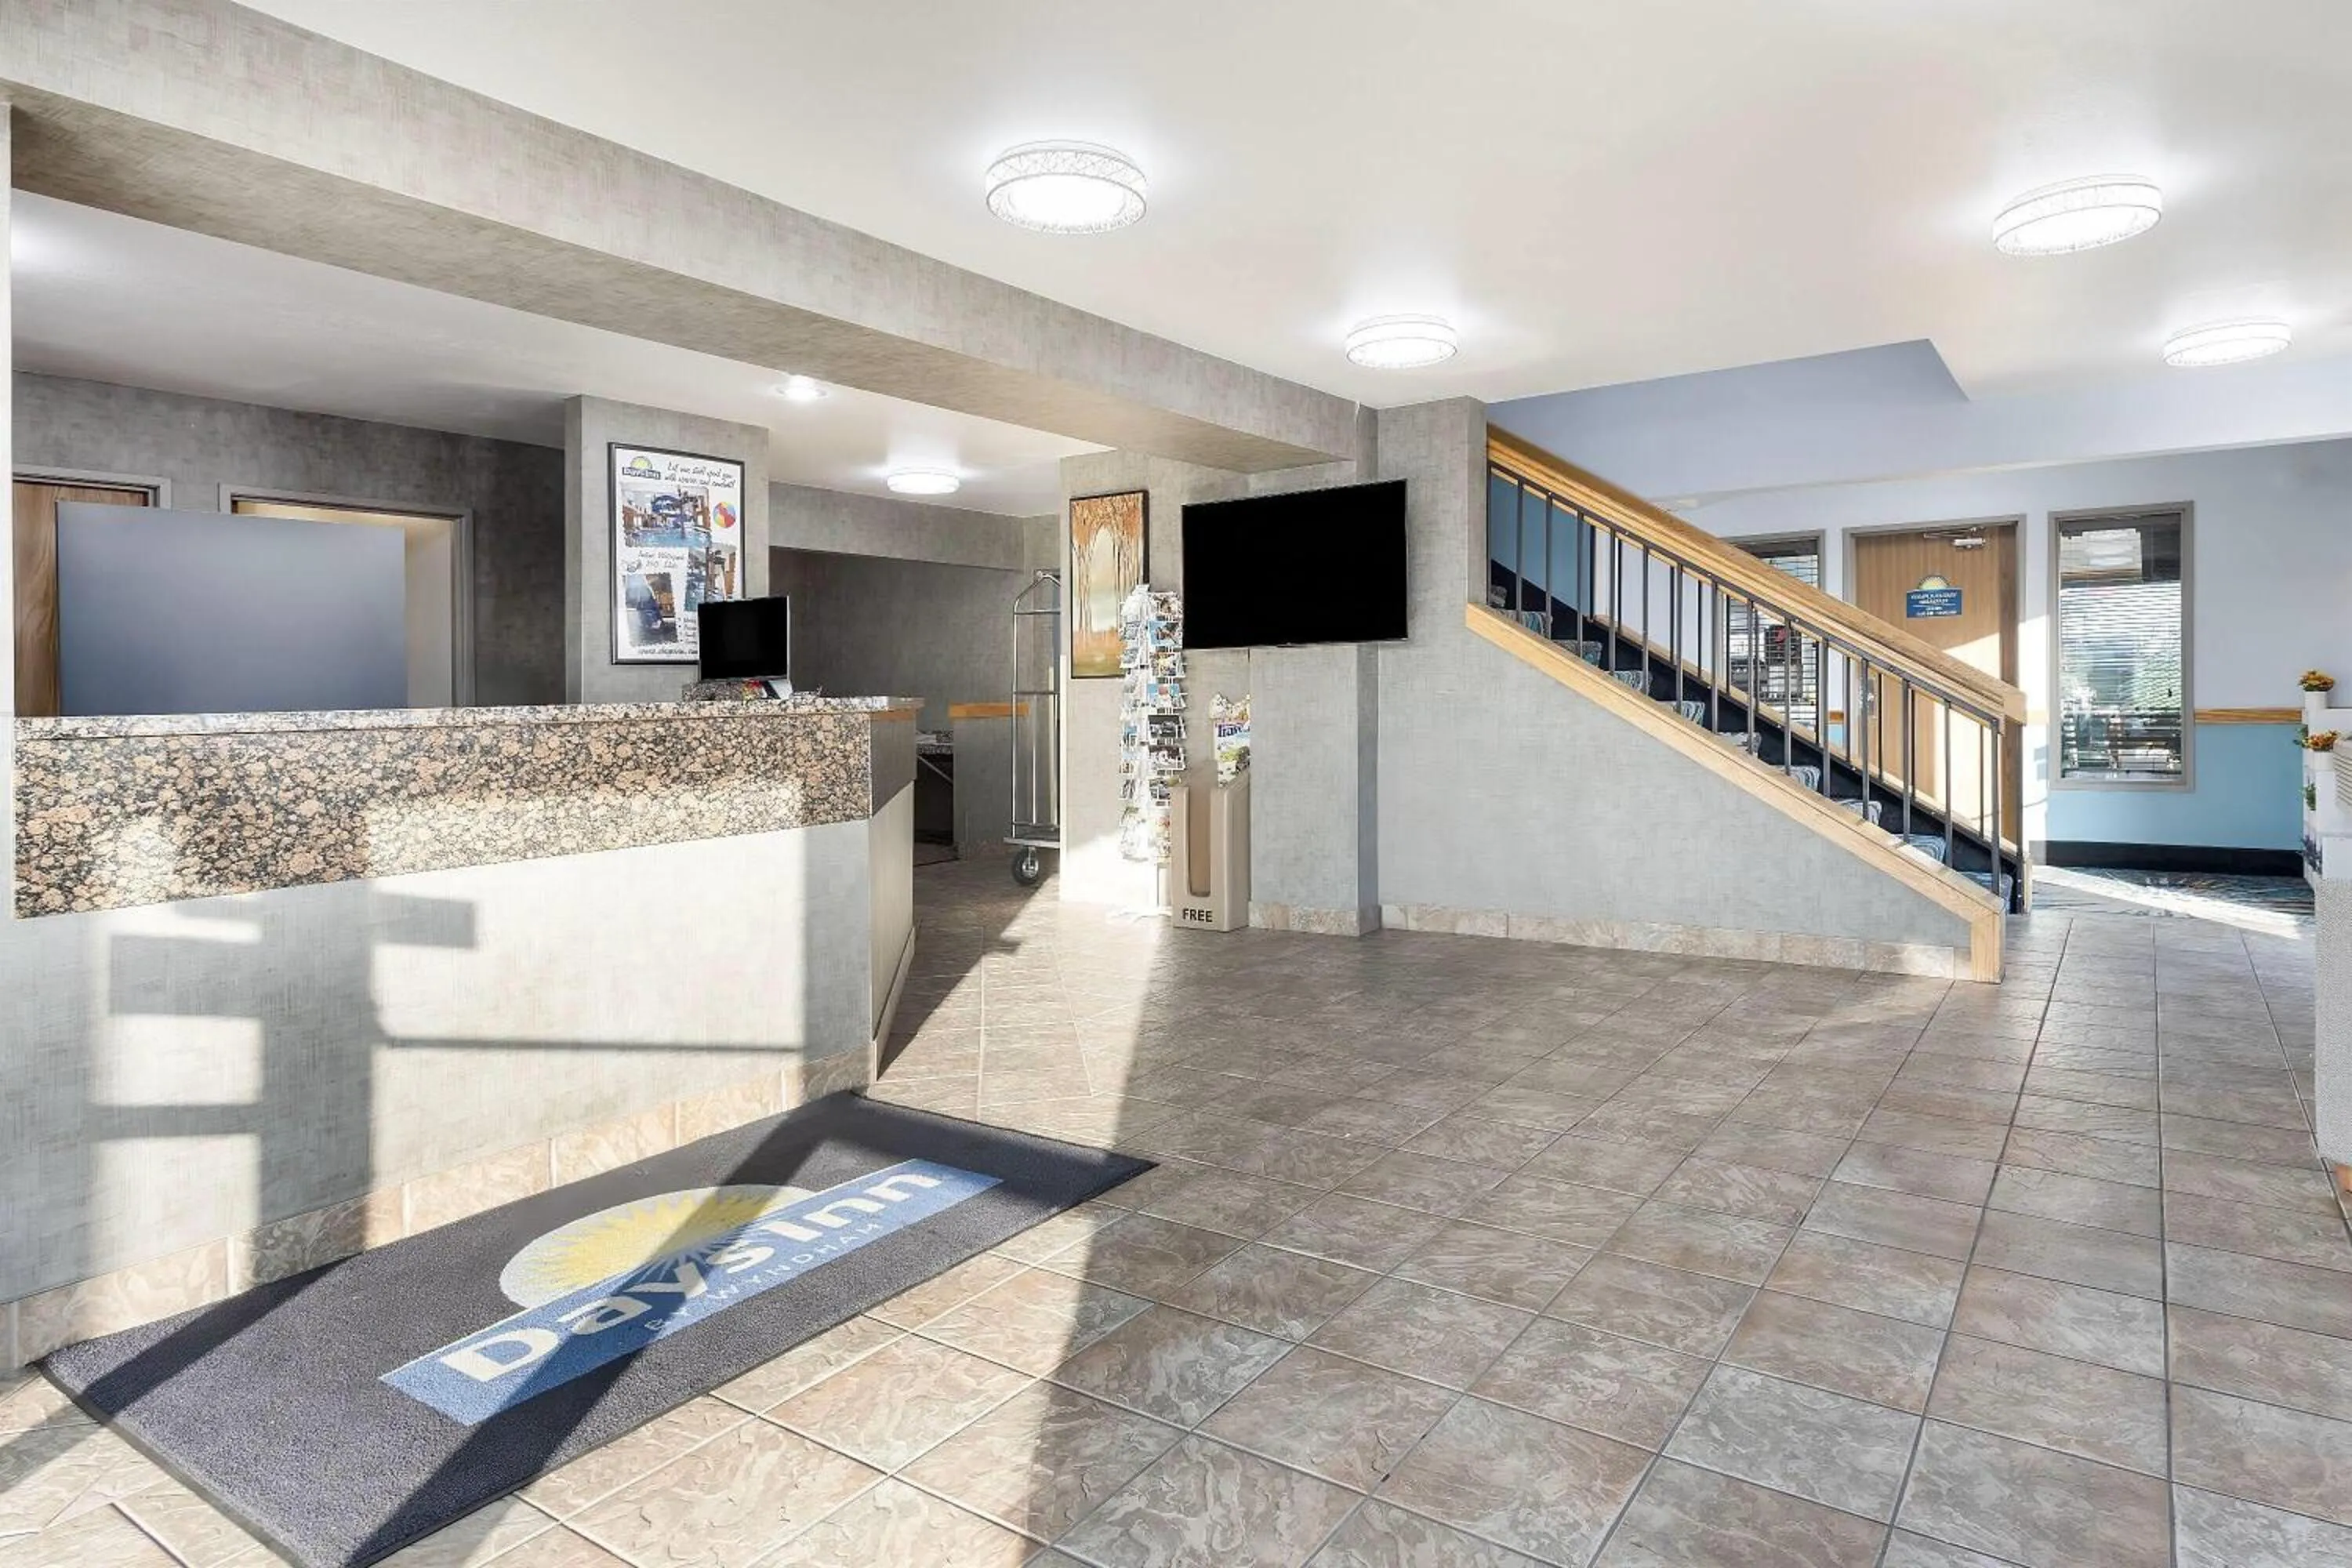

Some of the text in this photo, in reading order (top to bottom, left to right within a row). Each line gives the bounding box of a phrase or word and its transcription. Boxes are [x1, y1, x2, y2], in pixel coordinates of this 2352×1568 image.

[1183, 908, 1213, 923] FREE
[644, 1218, 884, 1332] BY WYNDHAM
